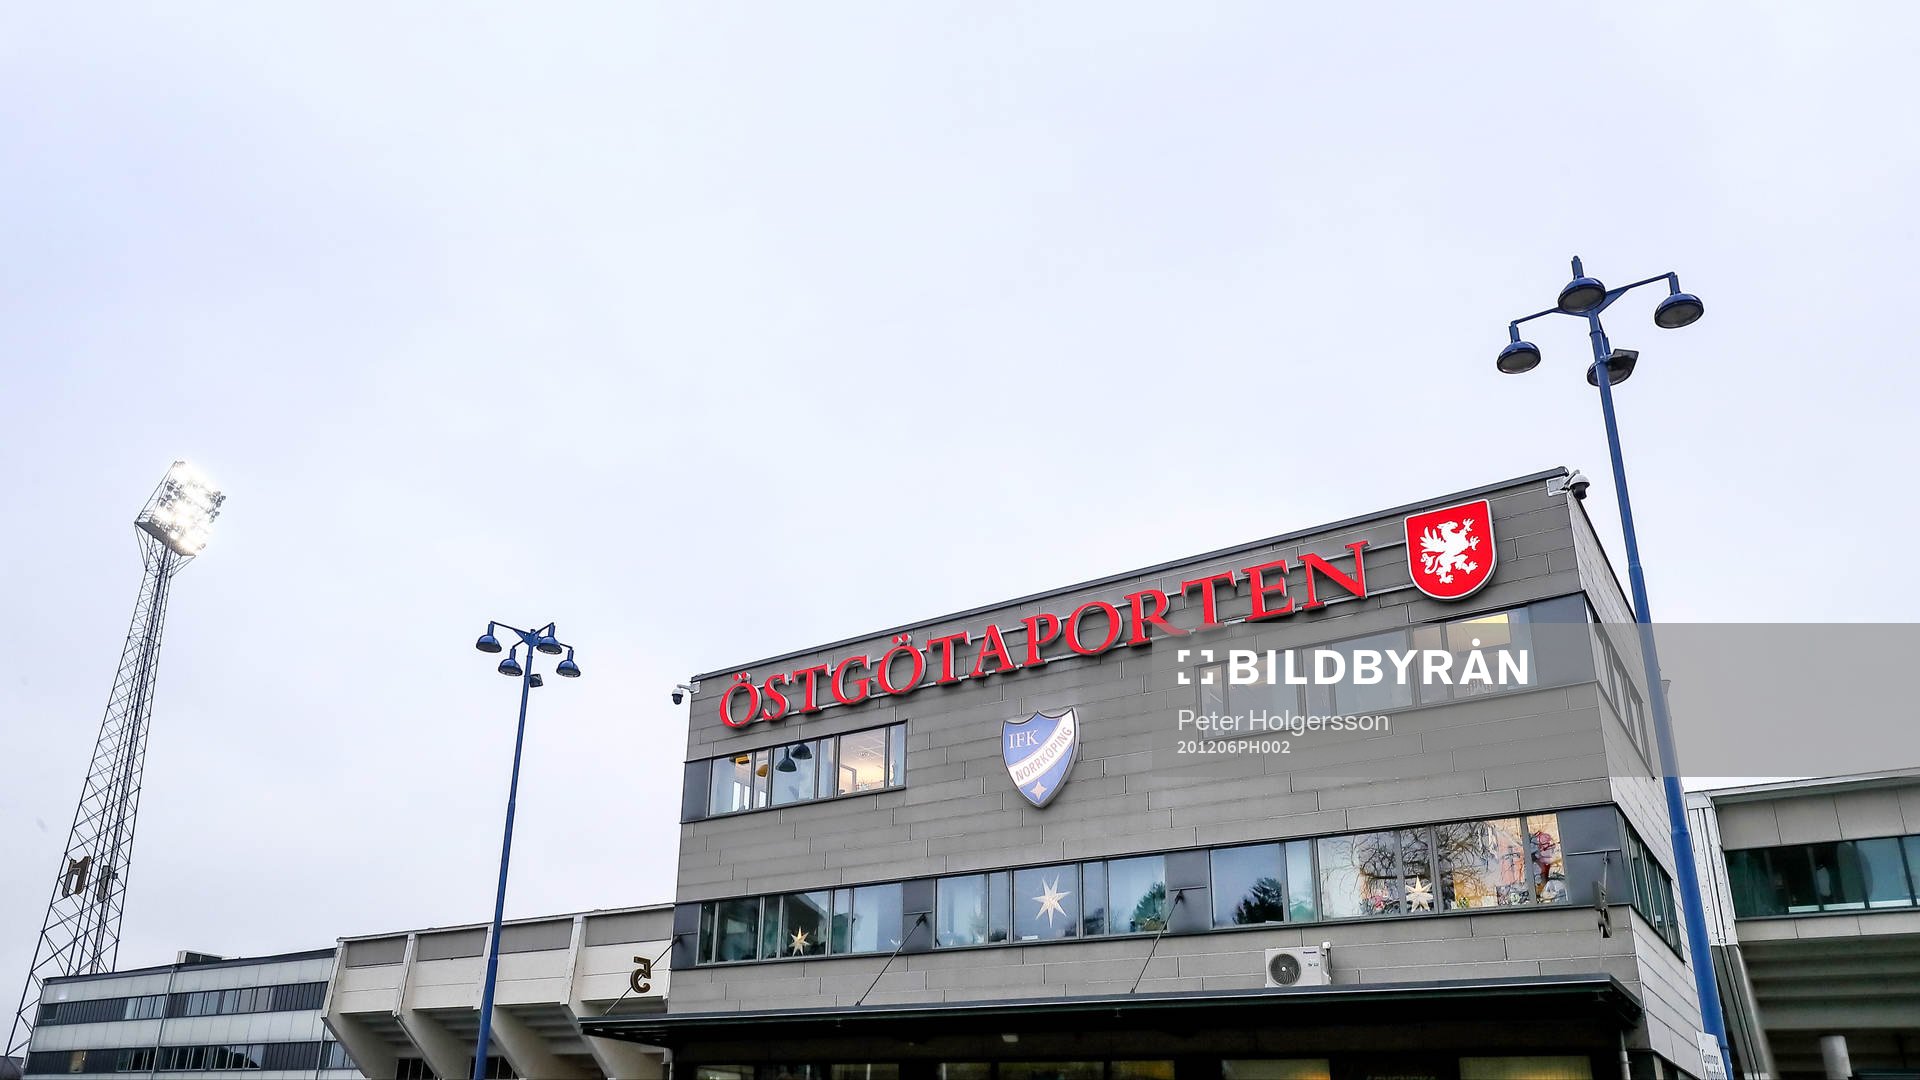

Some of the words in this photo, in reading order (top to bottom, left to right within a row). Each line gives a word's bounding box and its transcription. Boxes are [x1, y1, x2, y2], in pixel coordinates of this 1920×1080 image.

[719, 540, 1370, 729] ÖSTGÖTAPORTEN
[1008, 729, 1039, 750] IFK
[1015, 727, 1072, 781] NORRKÖPING
